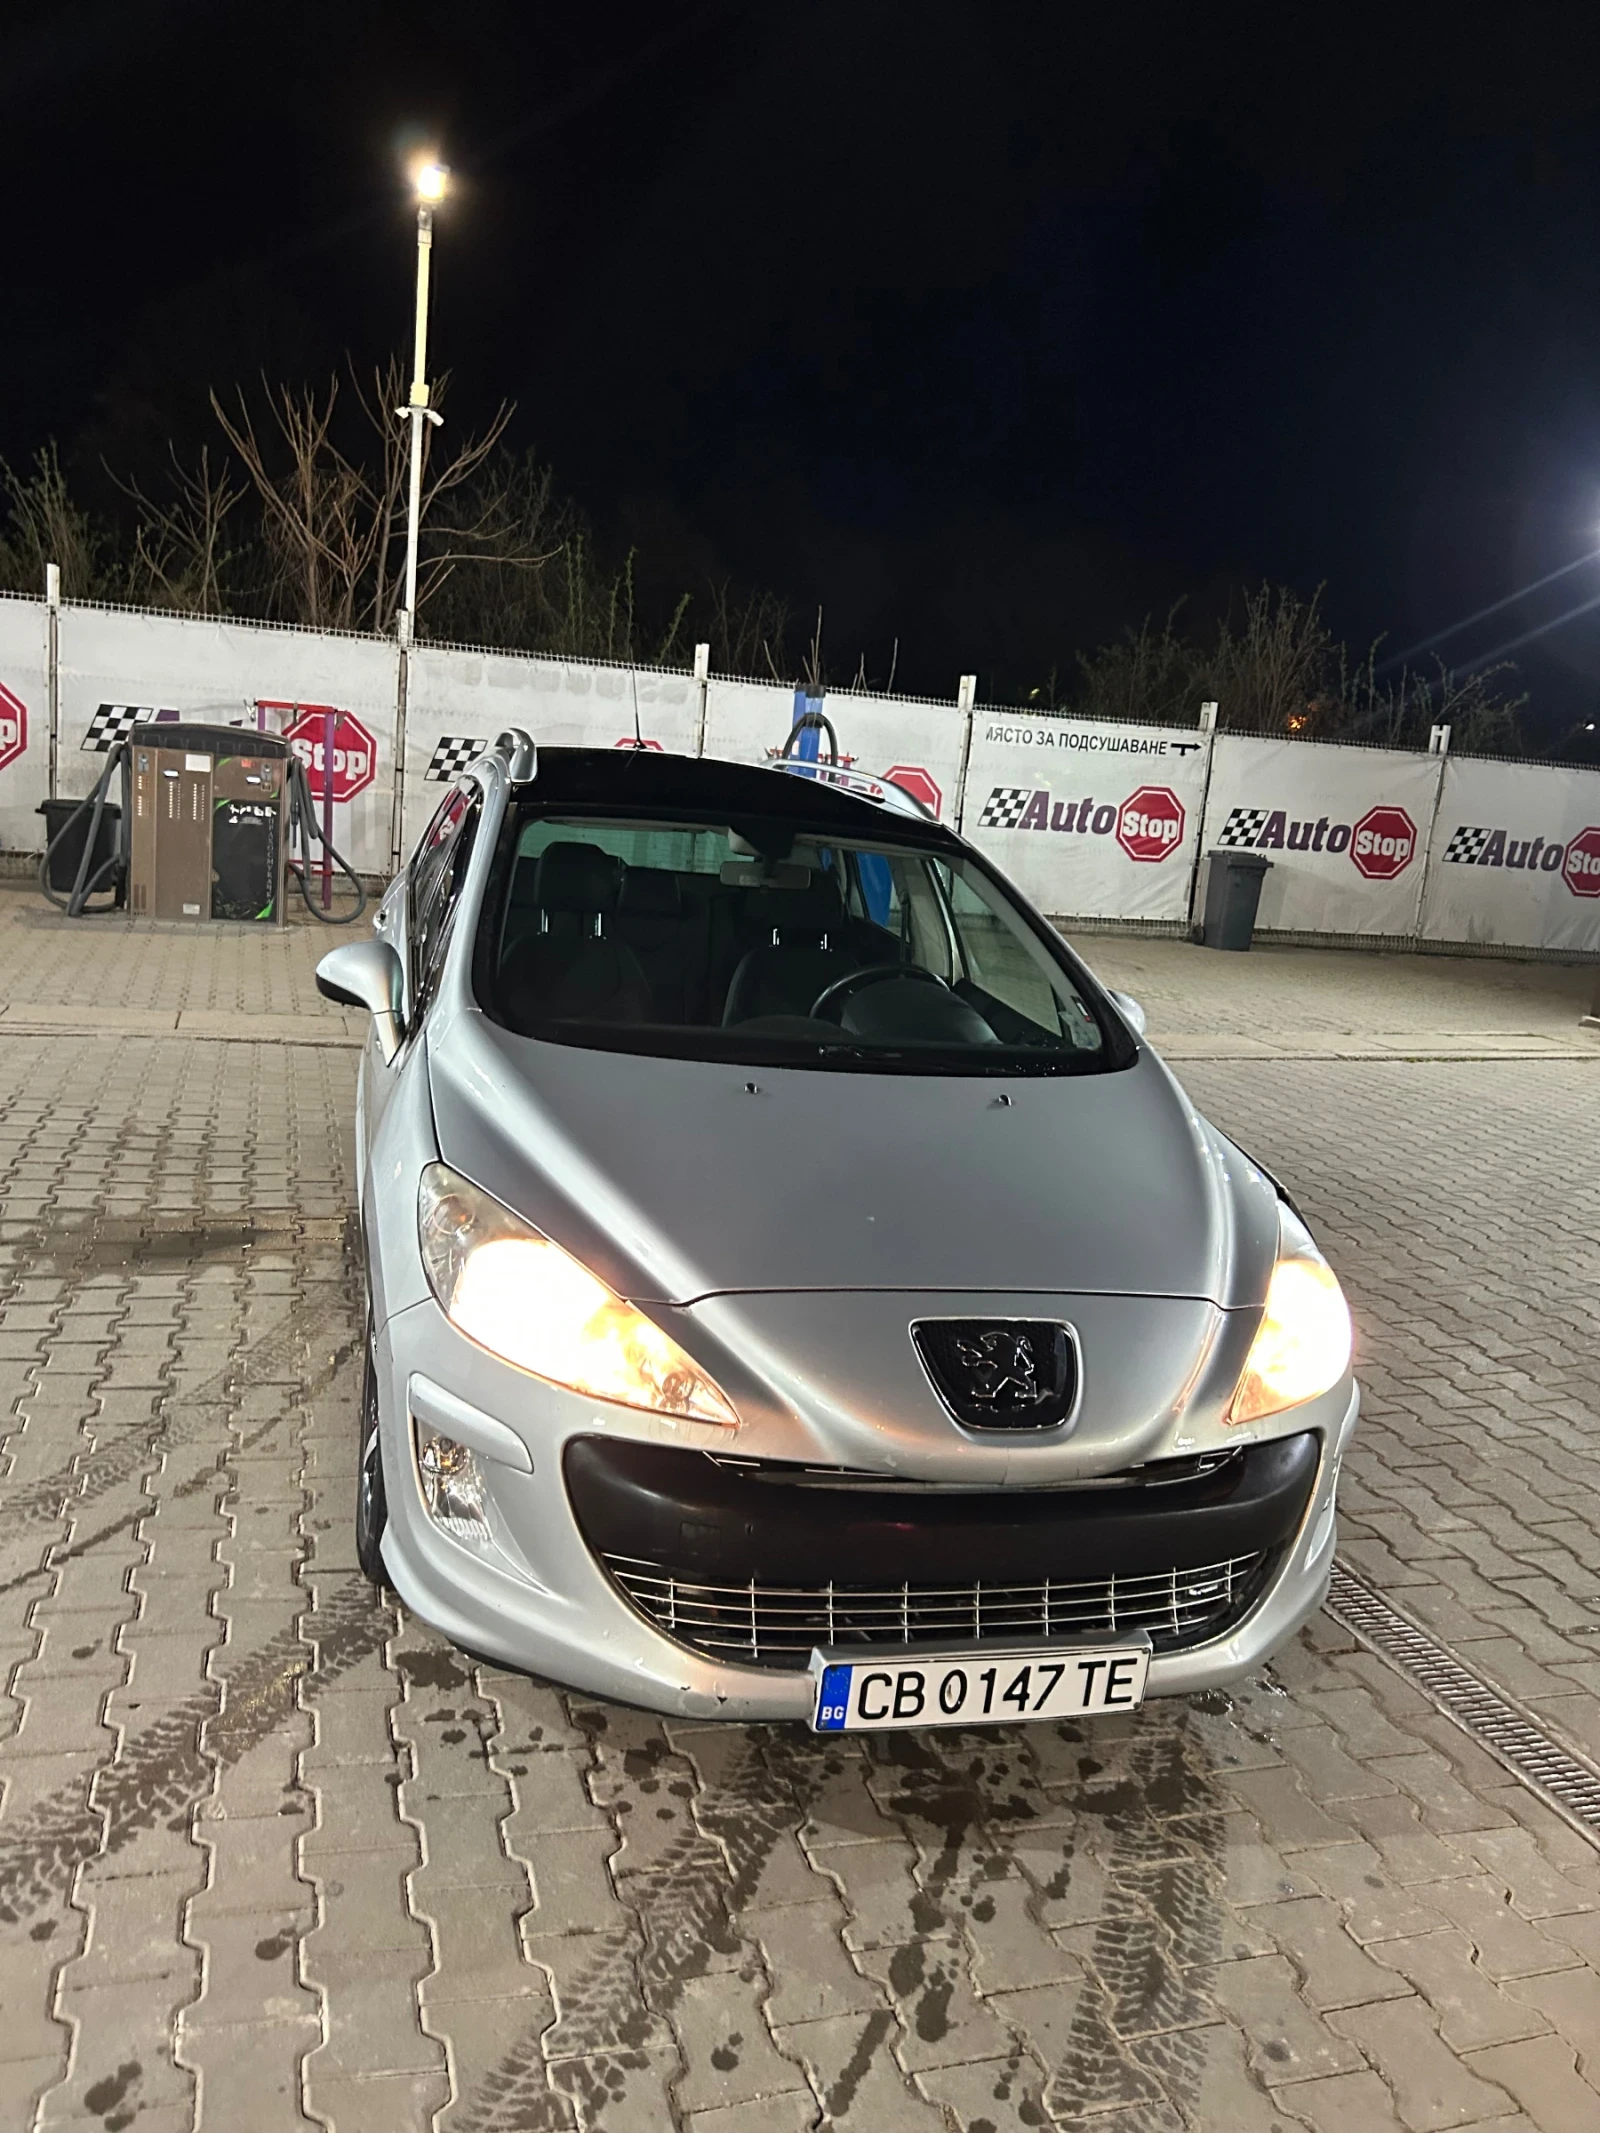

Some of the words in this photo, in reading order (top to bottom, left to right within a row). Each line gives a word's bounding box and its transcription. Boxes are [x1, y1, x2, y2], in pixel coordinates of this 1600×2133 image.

[291, 738, 367, 780] Stop
[1036, 731, 1055, 746] ЗА
[1059, 733, 1168, 755] ПОДСУШАВАНЕ
[1019, 791, 1117, 834] Auto
[1123, 811, 1178, 844] Stop
[1257, 811, 1353, 853] Auto
[1357, 831, 1411, 862] Stop
[1477, 829, 1565, 872] Auto
[1569, 850, 1600, 876] Sto
[822, 1705, 846, 1721] BG
[857, 1671, 926, 1721] CB
[938, 1663, 1066, 1715] 0147
[1077, 1658, 1138, 1707] TE
